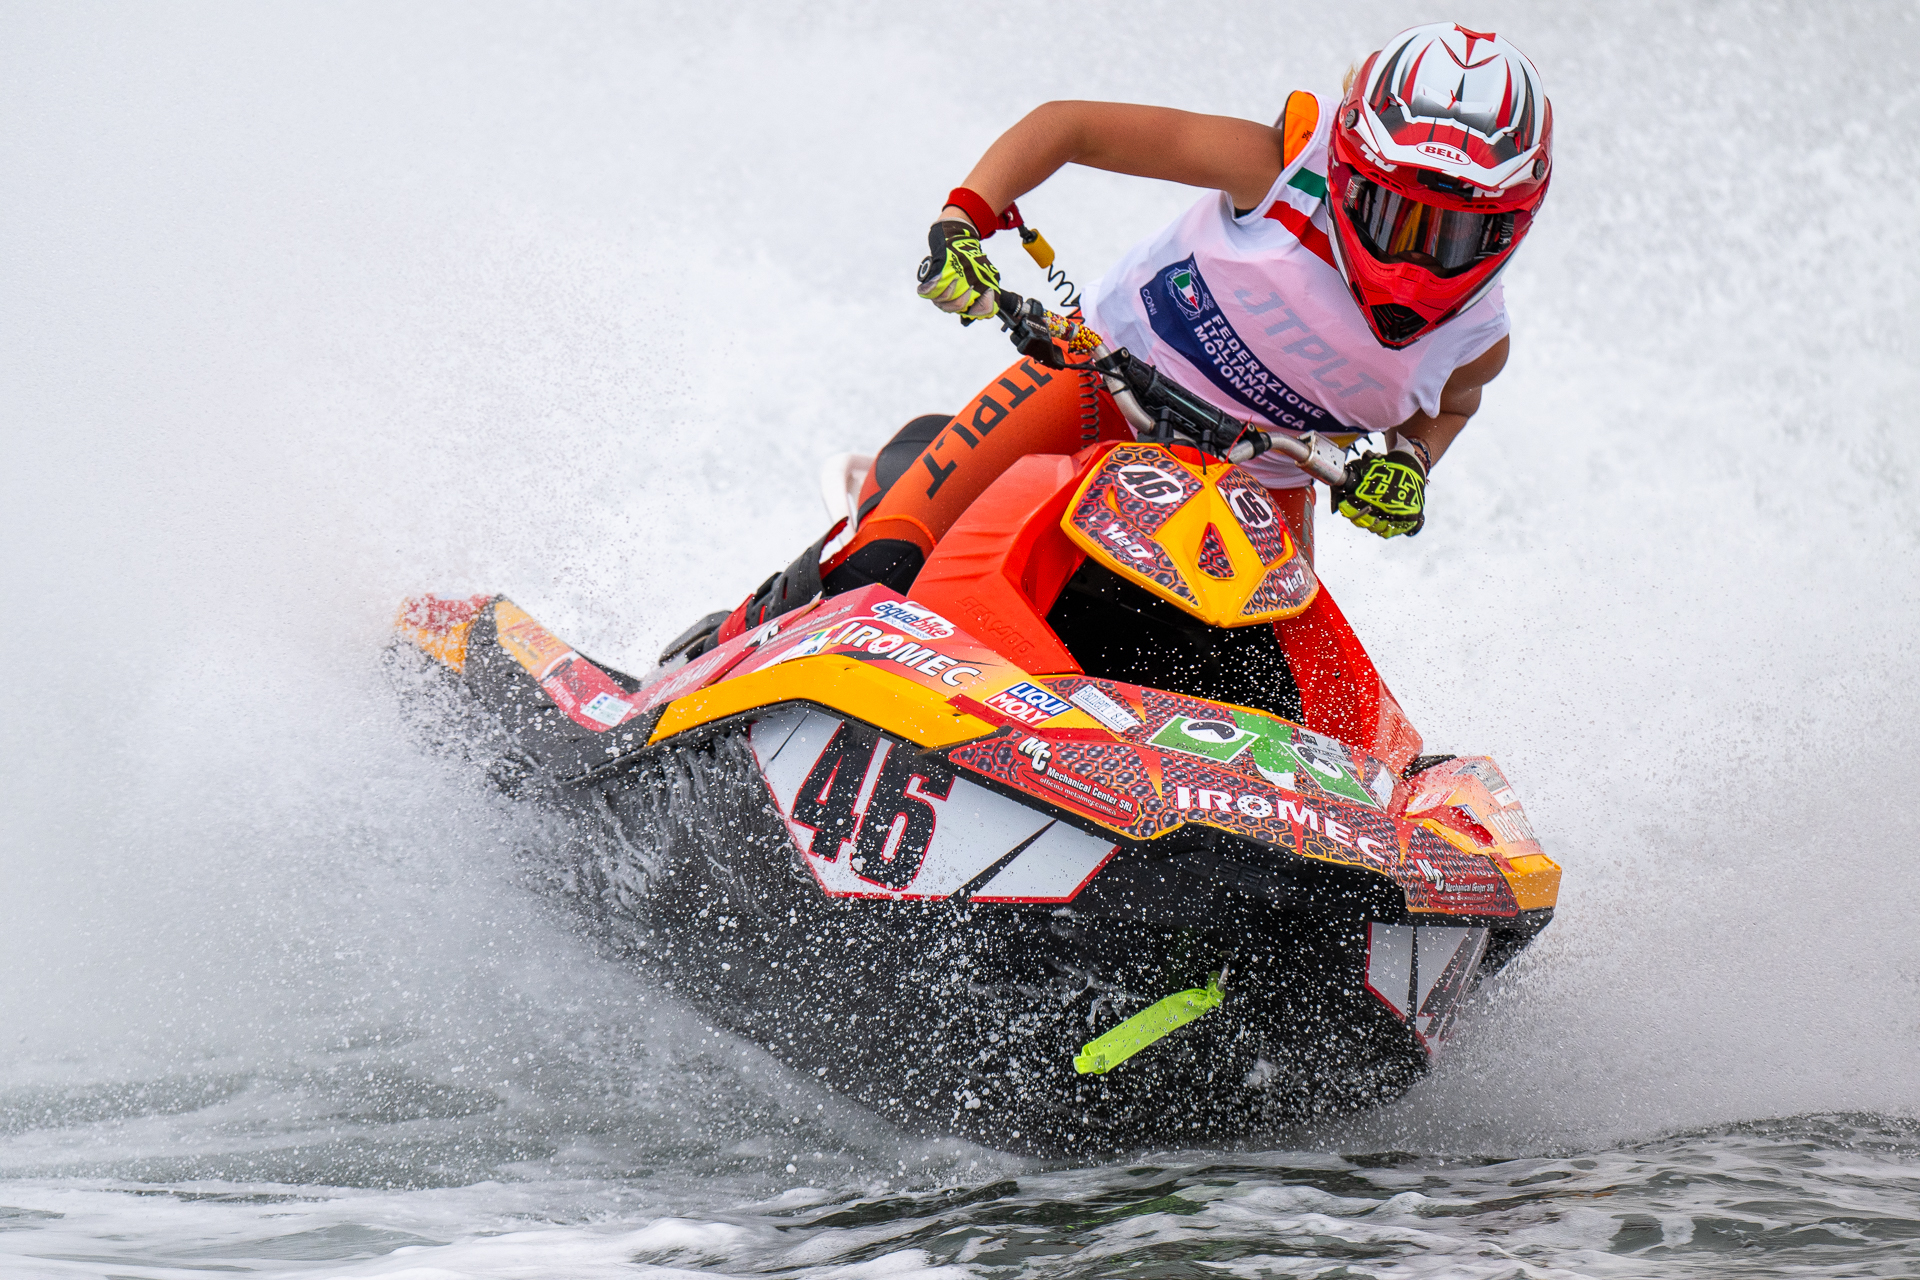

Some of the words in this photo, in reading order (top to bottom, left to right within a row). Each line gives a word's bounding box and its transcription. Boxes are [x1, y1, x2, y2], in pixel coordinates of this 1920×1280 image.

[1424, 145, 1463, 163] BELL
[1142, 288, 1157, 316] CONI
[1202, 320, 1267, 395] ITALIANA
[1210, 314, 1326, 419] FEDERAZIONE
[1193, 325, 1306, 430] MOTONAUTICA
[1120, 469, 1181, 499] 46
[1234, 491, 1272, 526] 46
[874, 603, 948, 637] aquabike
[831, 621, 983, 687] IROMEC
[989, 693, 1050, 725] MOLY
[1009, 683, 1068, 715] LIQUI
[1018, 737, 1051, 772] MC
[1040, 778, 1064, 792] officina
[1047, 767, 1092, 793] Mechanical
[1092, 784, 1118, 806] Center
[1119, 799, 1133, 813] SRL
[790, 722, 956, 892] 46
[1176, 786, 1387, 863] IROMEC
